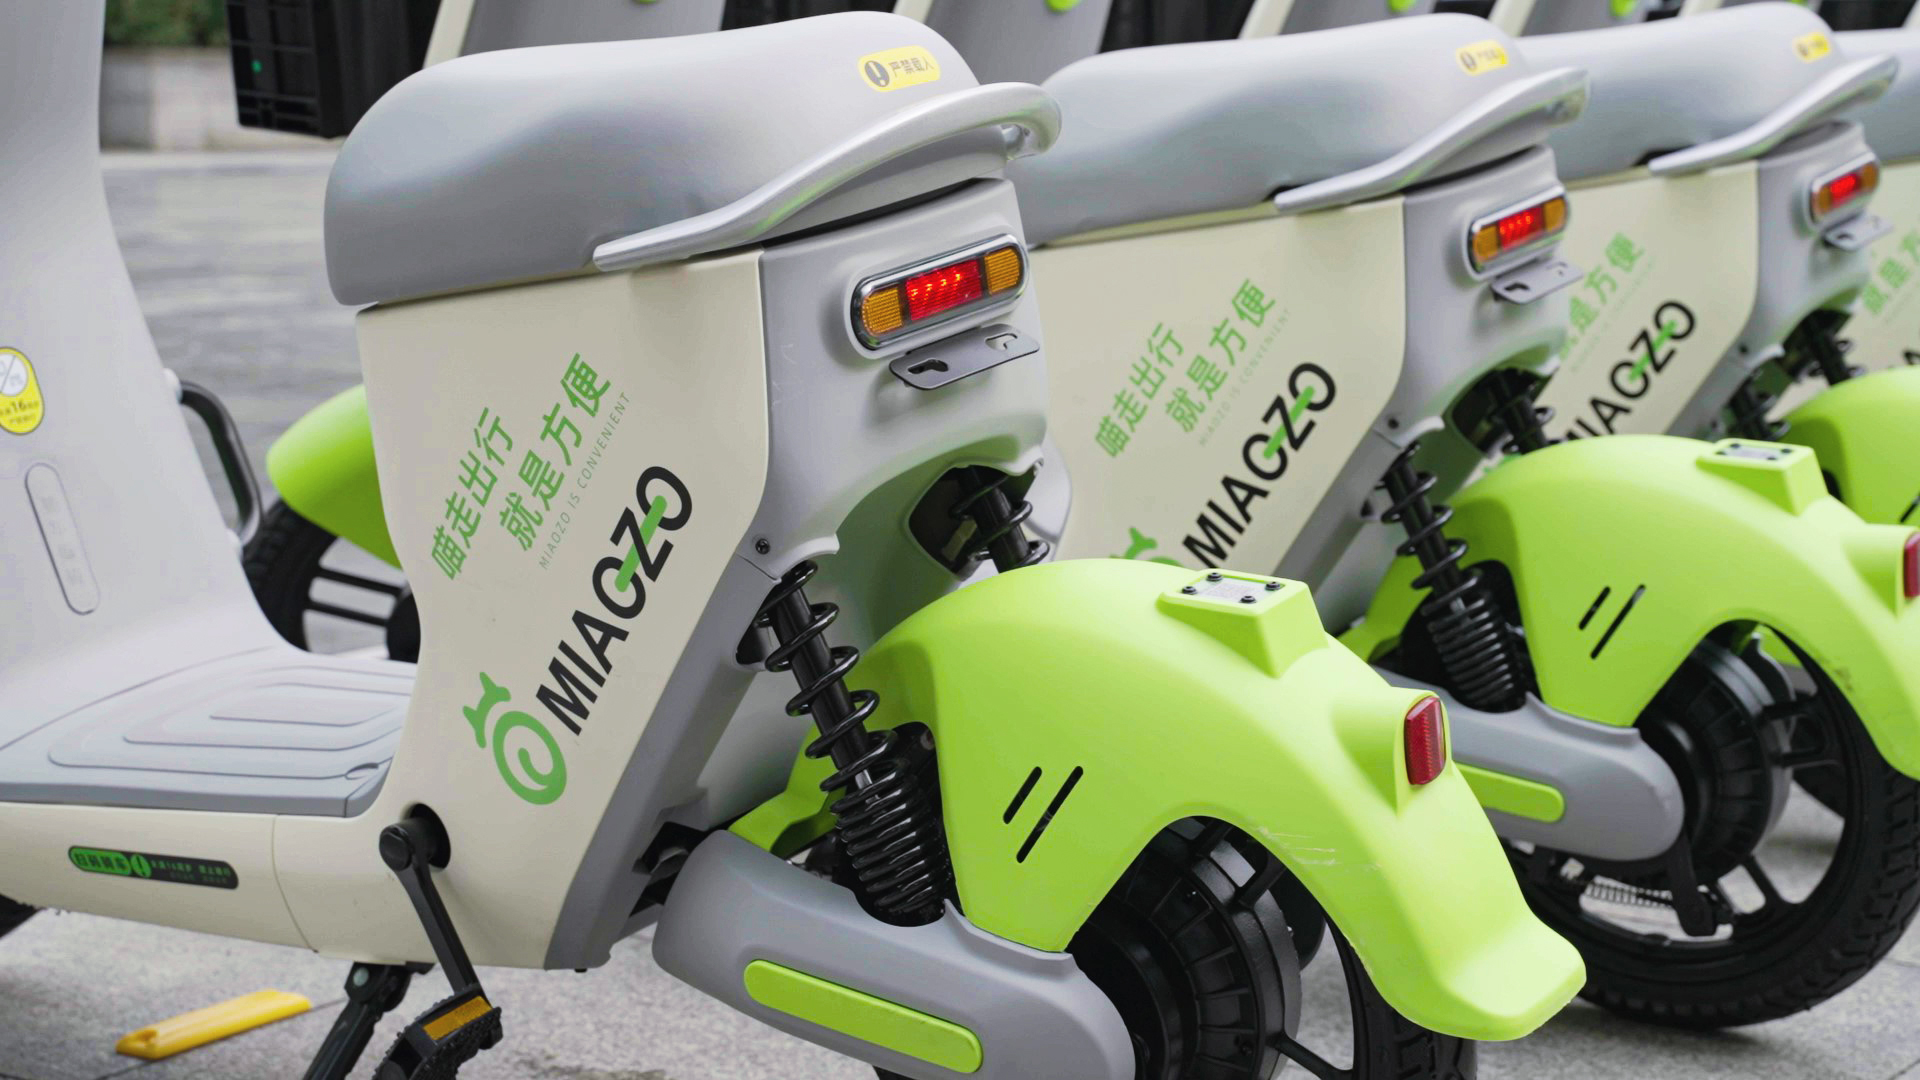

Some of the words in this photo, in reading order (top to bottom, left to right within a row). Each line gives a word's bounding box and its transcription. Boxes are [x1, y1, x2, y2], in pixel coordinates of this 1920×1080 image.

[888, 56, 934, 78] 严禁载人
[1094, 322, 1185, 459] 喵走出行
[1164, 278, 1276, 433] 就是方便
[1566, 302, 1695, 438] IAOZO
[431, 407, 513, 580] 喵走出行
[499, 352, 611, 552] 就是方便
[538, 512, 571, 570] MIAOZO
[570, 493, 581, 510] IS
[577, 391, 631, 489] CONVENIENT
[1182, 362, 1336, 570] MIAOZO
[536, 466, 692, 736] MIAOZO
